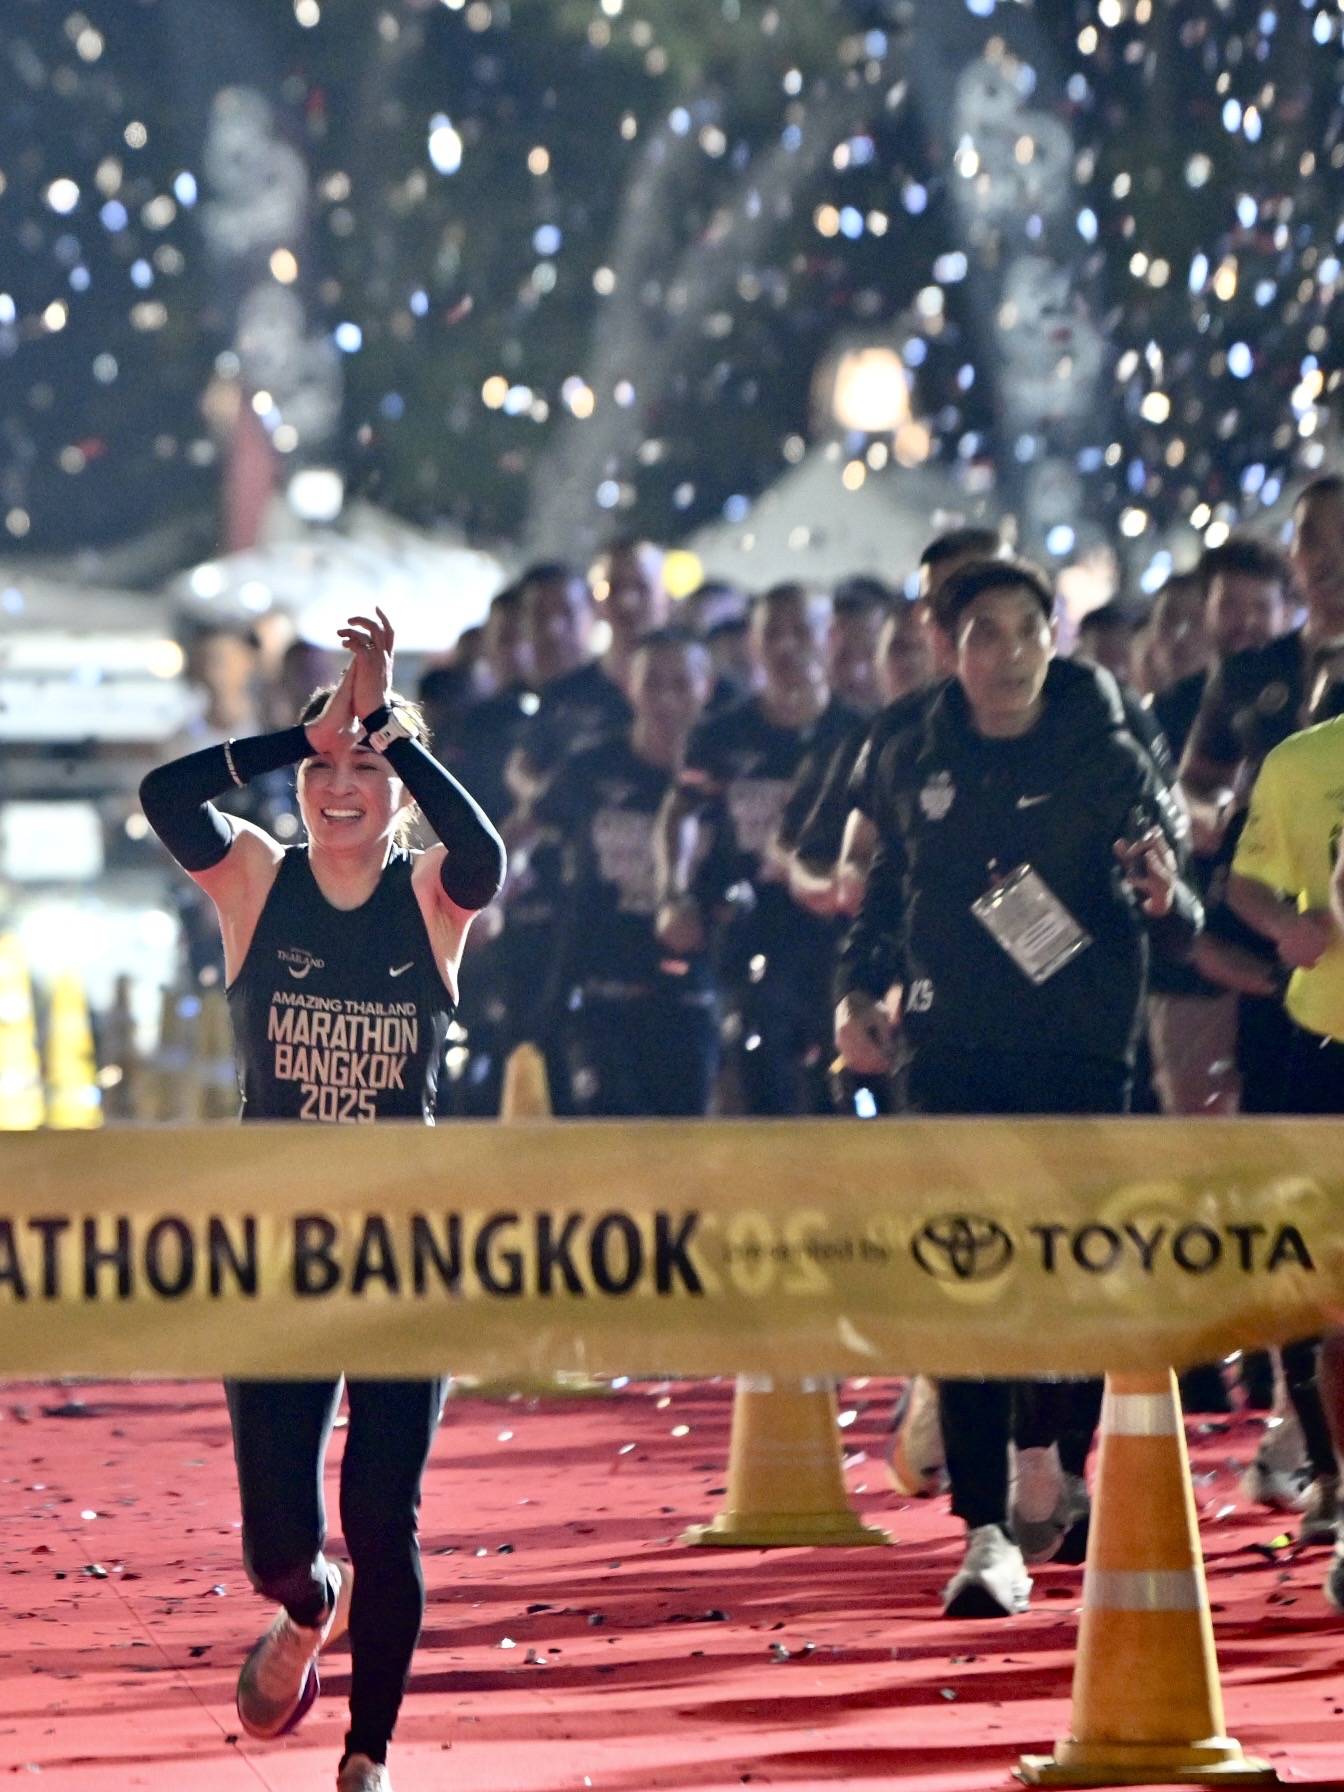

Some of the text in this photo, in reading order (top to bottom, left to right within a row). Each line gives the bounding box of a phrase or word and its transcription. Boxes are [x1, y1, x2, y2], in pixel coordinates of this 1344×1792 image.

[272, 991, 416, 1016] AMAZING THAILAND
[267, 1005, 418, 1054] MARATHON
[275, 1044, 405, 1089] BANGKOK
[300, 1083, 378, 1124] 2025
[292, 1212, 704, 1299] BANGKOK
[1027, 1222, 1316, 1277] TOYOTA
